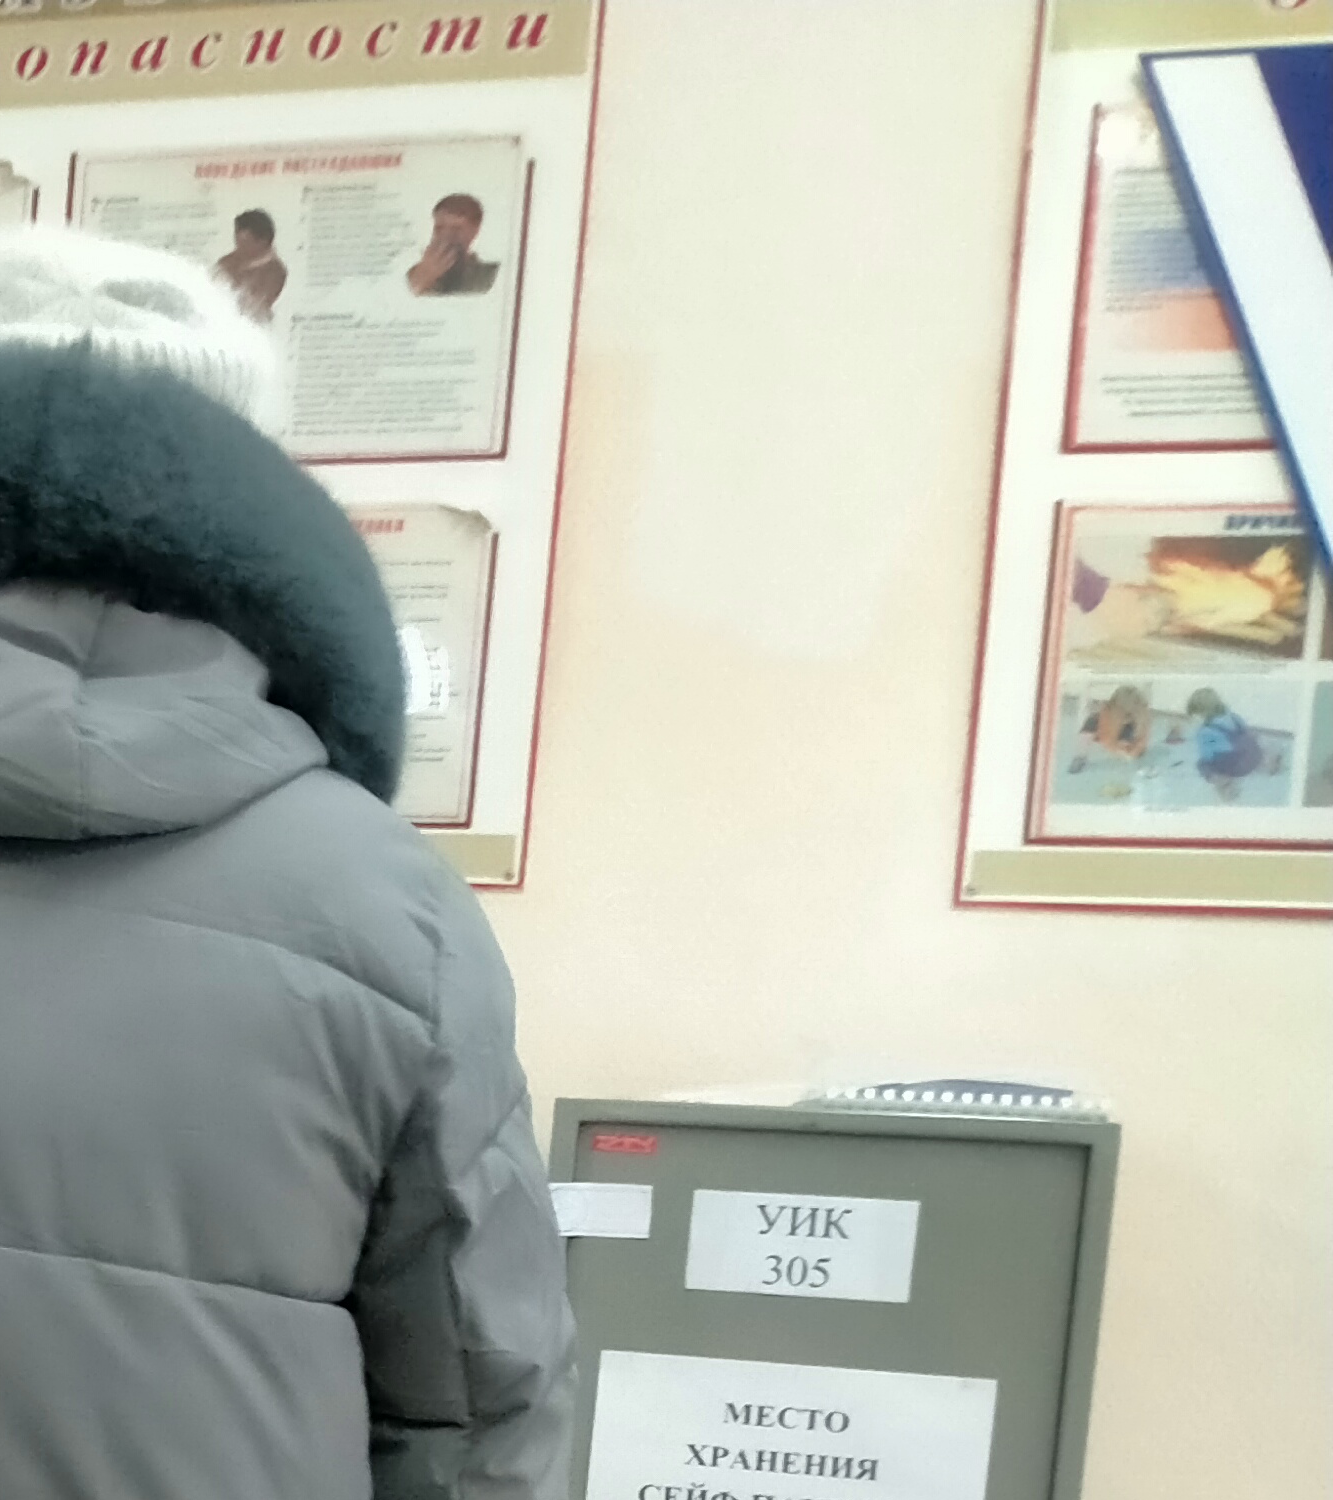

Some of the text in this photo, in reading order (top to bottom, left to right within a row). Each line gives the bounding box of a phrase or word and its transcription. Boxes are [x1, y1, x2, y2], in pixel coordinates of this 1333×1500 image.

[757, 1203, 853, 1240] УИК
[762, 1254, 831, 1288] 305
[723, 1401, 850, 1435] МЕСТО
[684, 1443, 879, 1482] ХРАНЕНИЯ
